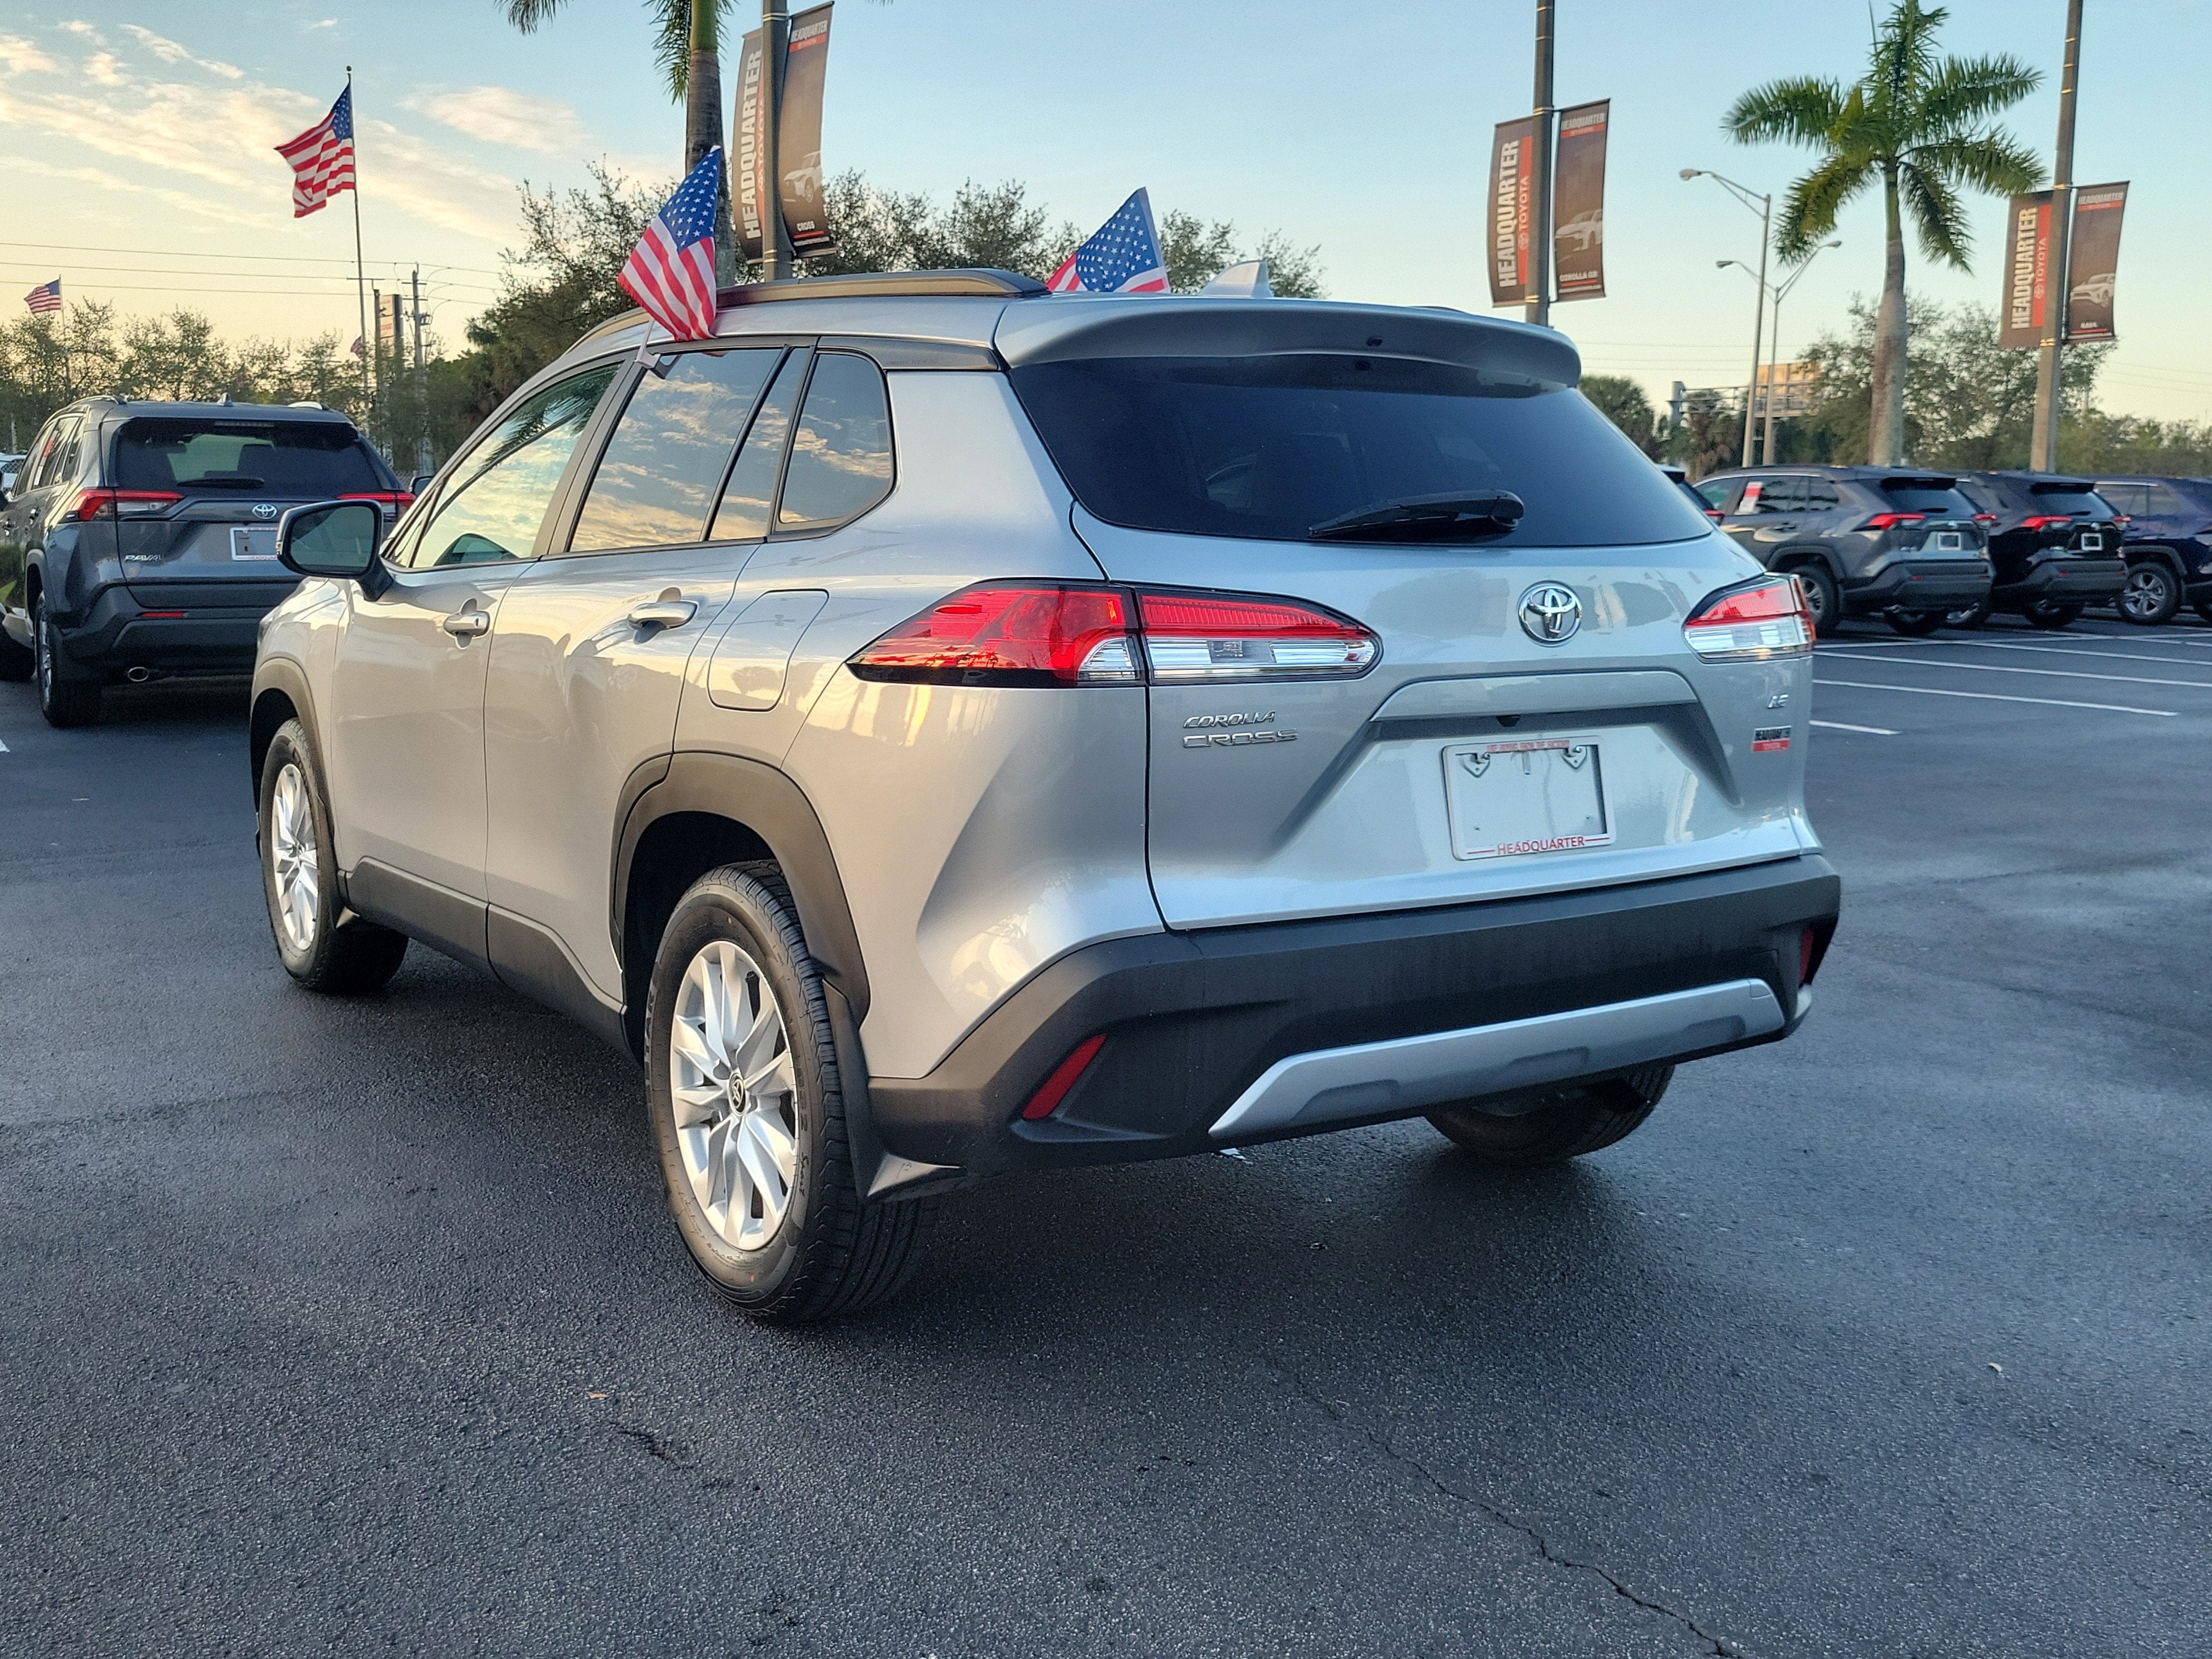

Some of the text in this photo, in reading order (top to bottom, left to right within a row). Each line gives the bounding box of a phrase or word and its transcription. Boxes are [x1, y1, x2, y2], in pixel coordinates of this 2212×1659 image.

[741, 50, 761, 240] HEADQUARTER
[1497, 139, 1520, 288] HEADQUARTER
[1519, 176, 1530, 230] TOYOTA
[2011, 206, 2038, 329] HEADQUARTER
[2034, 236, 2047, 284] TOYOTA
[1183, 710, 1276, 729] COROLLA
[1183, 728, 1299, 748] CROSS
[1497, 836, 1585, 855] HEADQUARTER
